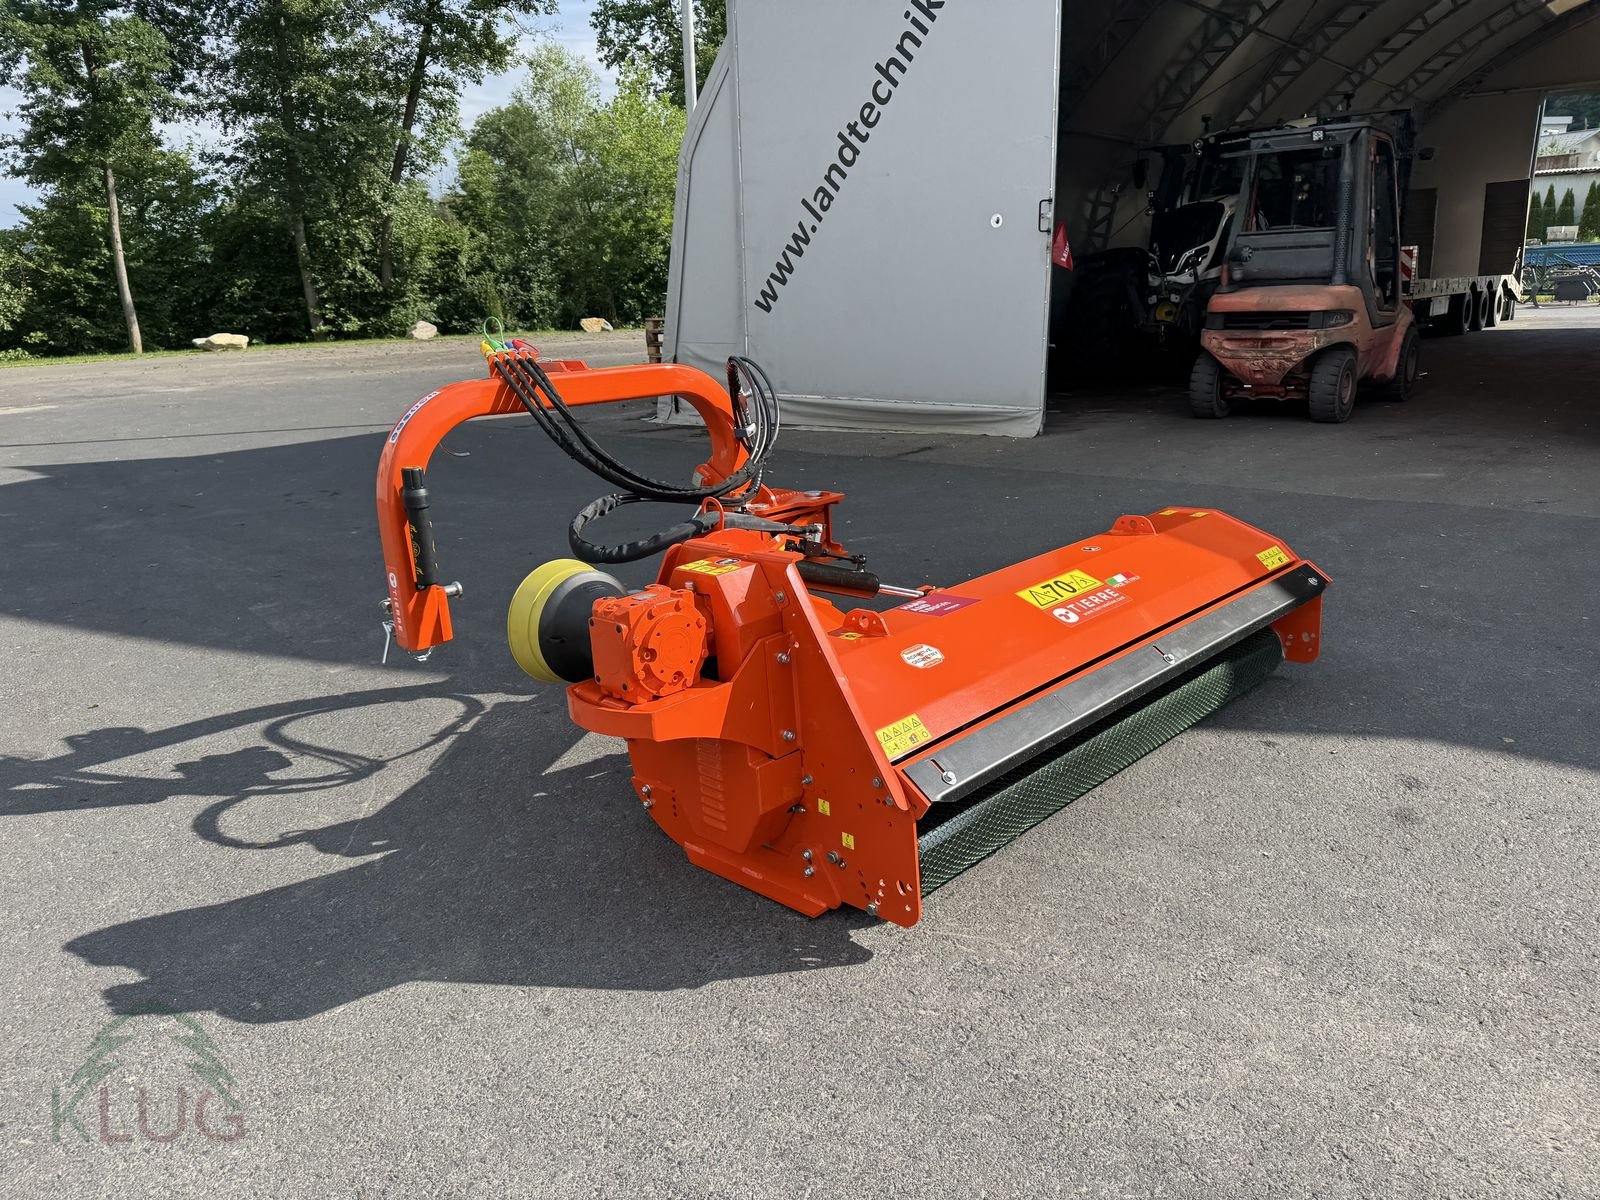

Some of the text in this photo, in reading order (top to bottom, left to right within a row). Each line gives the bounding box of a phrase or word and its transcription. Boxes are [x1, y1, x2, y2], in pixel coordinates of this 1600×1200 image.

[1041, 580, 1078, 598] 70
[1066, 588, 1120, 613] TIERRE
[391, 590, 404, 632] TIERRE
